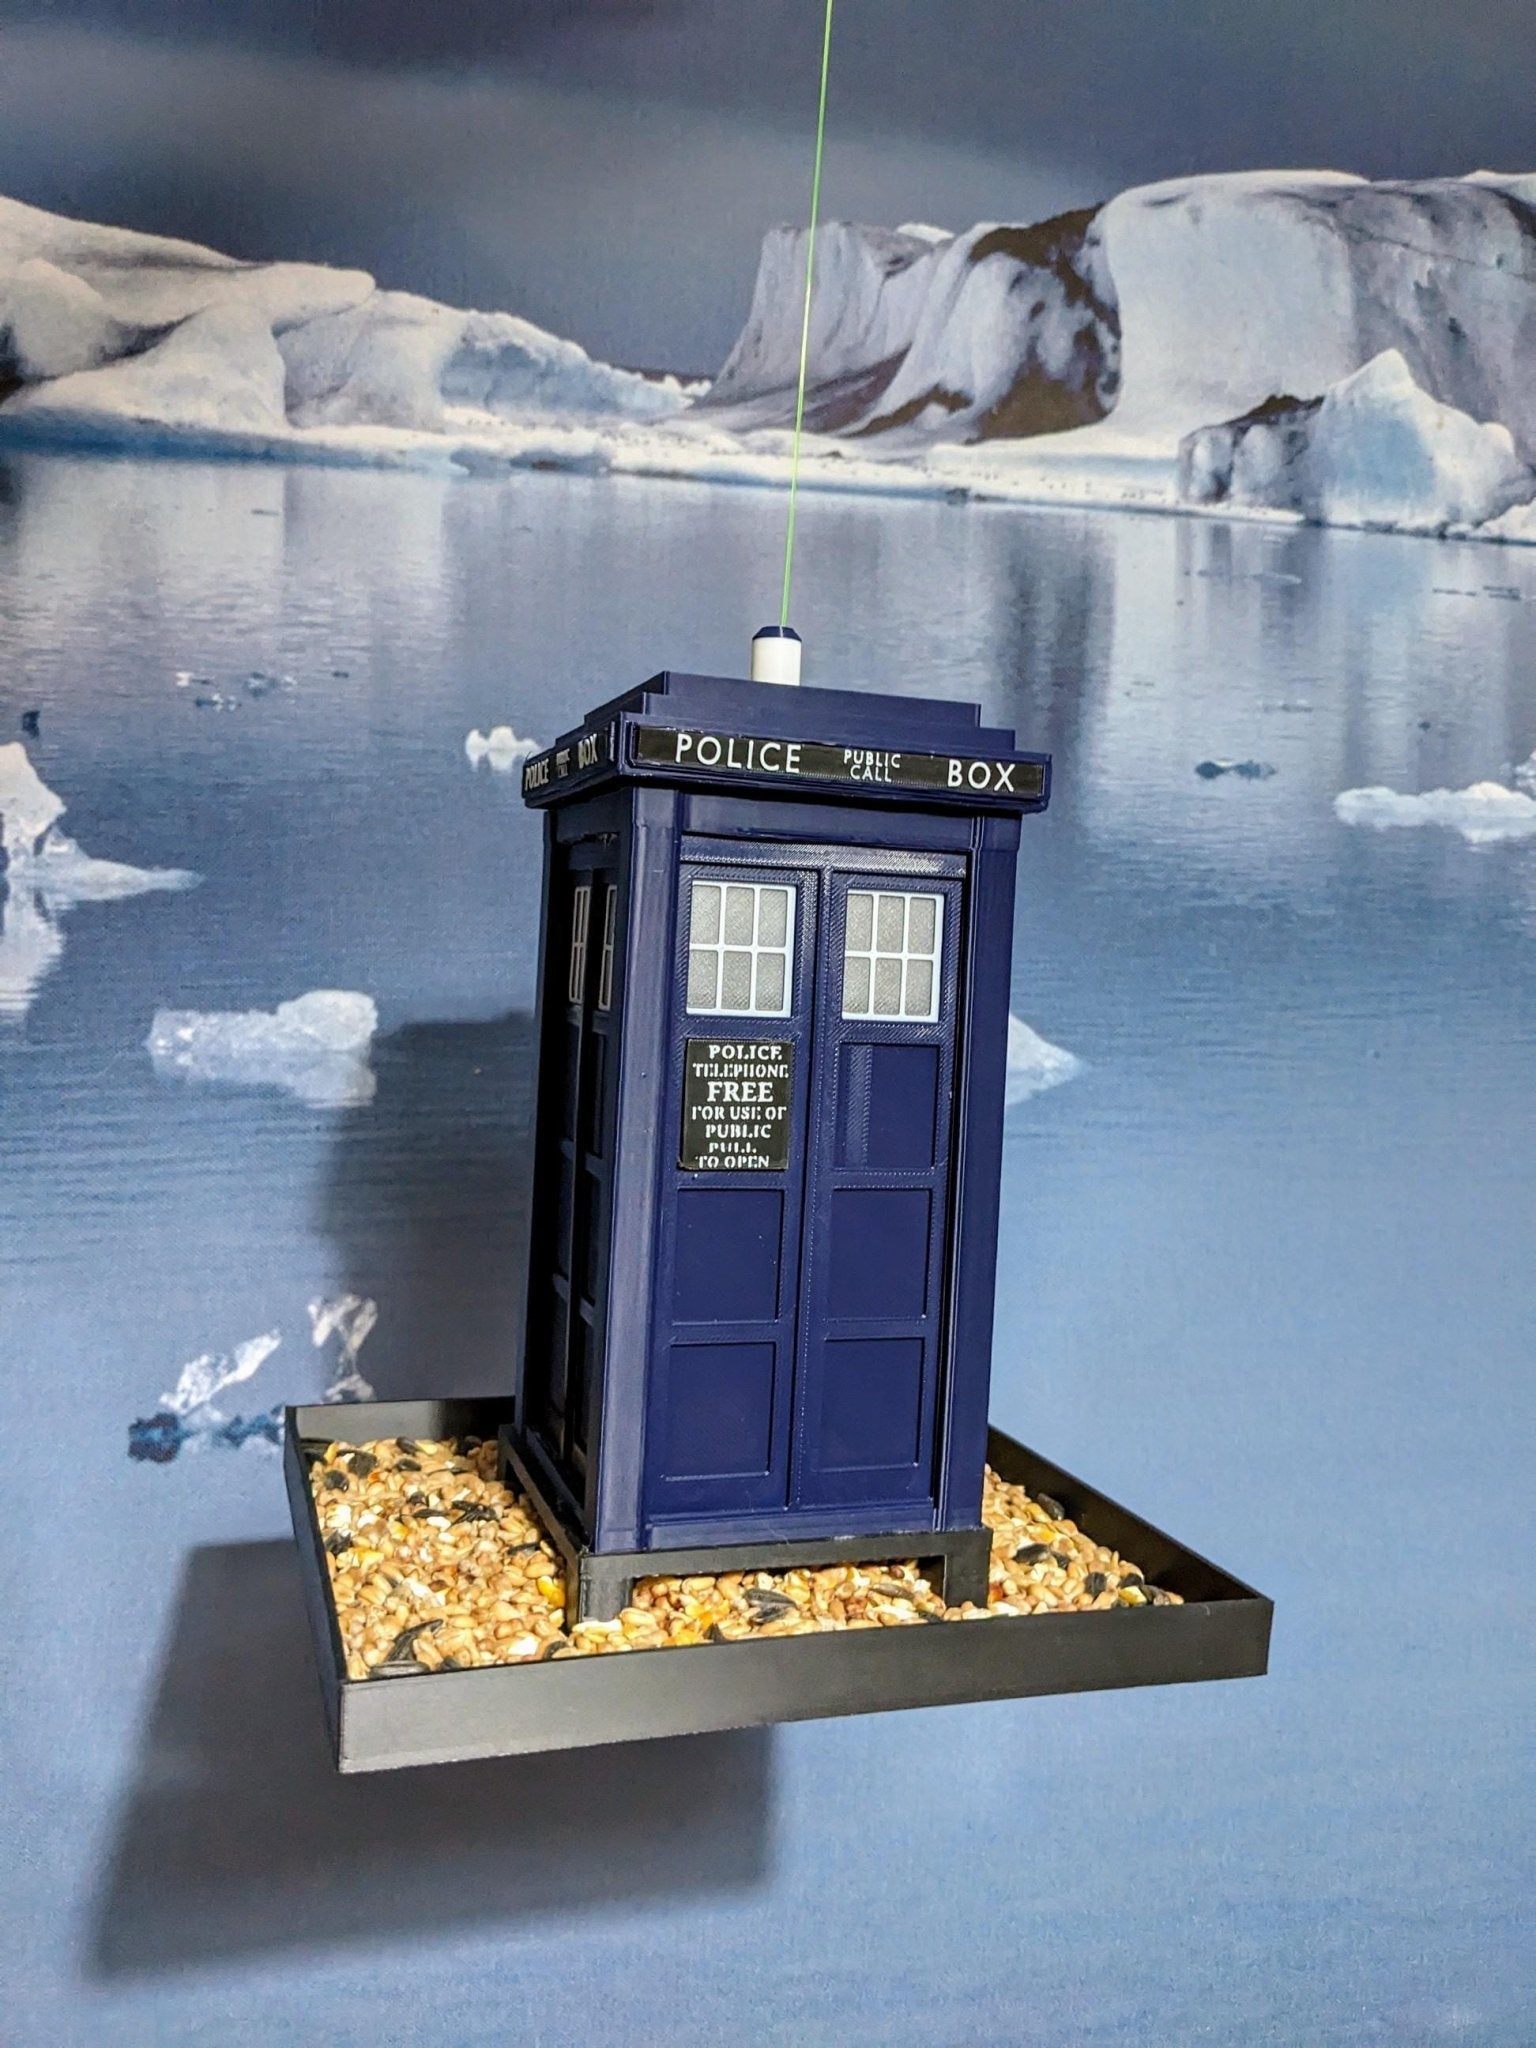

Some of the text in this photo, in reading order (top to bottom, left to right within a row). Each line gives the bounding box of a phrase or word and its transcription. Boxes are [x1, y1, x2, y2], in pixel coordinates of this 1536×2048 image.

[578, 733, 598, 769] BOX
[843, 749, 901, 769] PUBLIC
[675, 733, 1016, 792] POLICE BOX
[850, 767, 892, 783] CALL
[708, 1044, 783, 1060] POLICE
[692, 1063, 789, 1078] TELEPHONE
[706, 1081, 774, 1102] FREE
[692, 1106, 787, 1121] FOR USE OF
[705, 1123, 772, 1138] PUBLIC
[695, 1155, 770, 1168] TO OPEN
